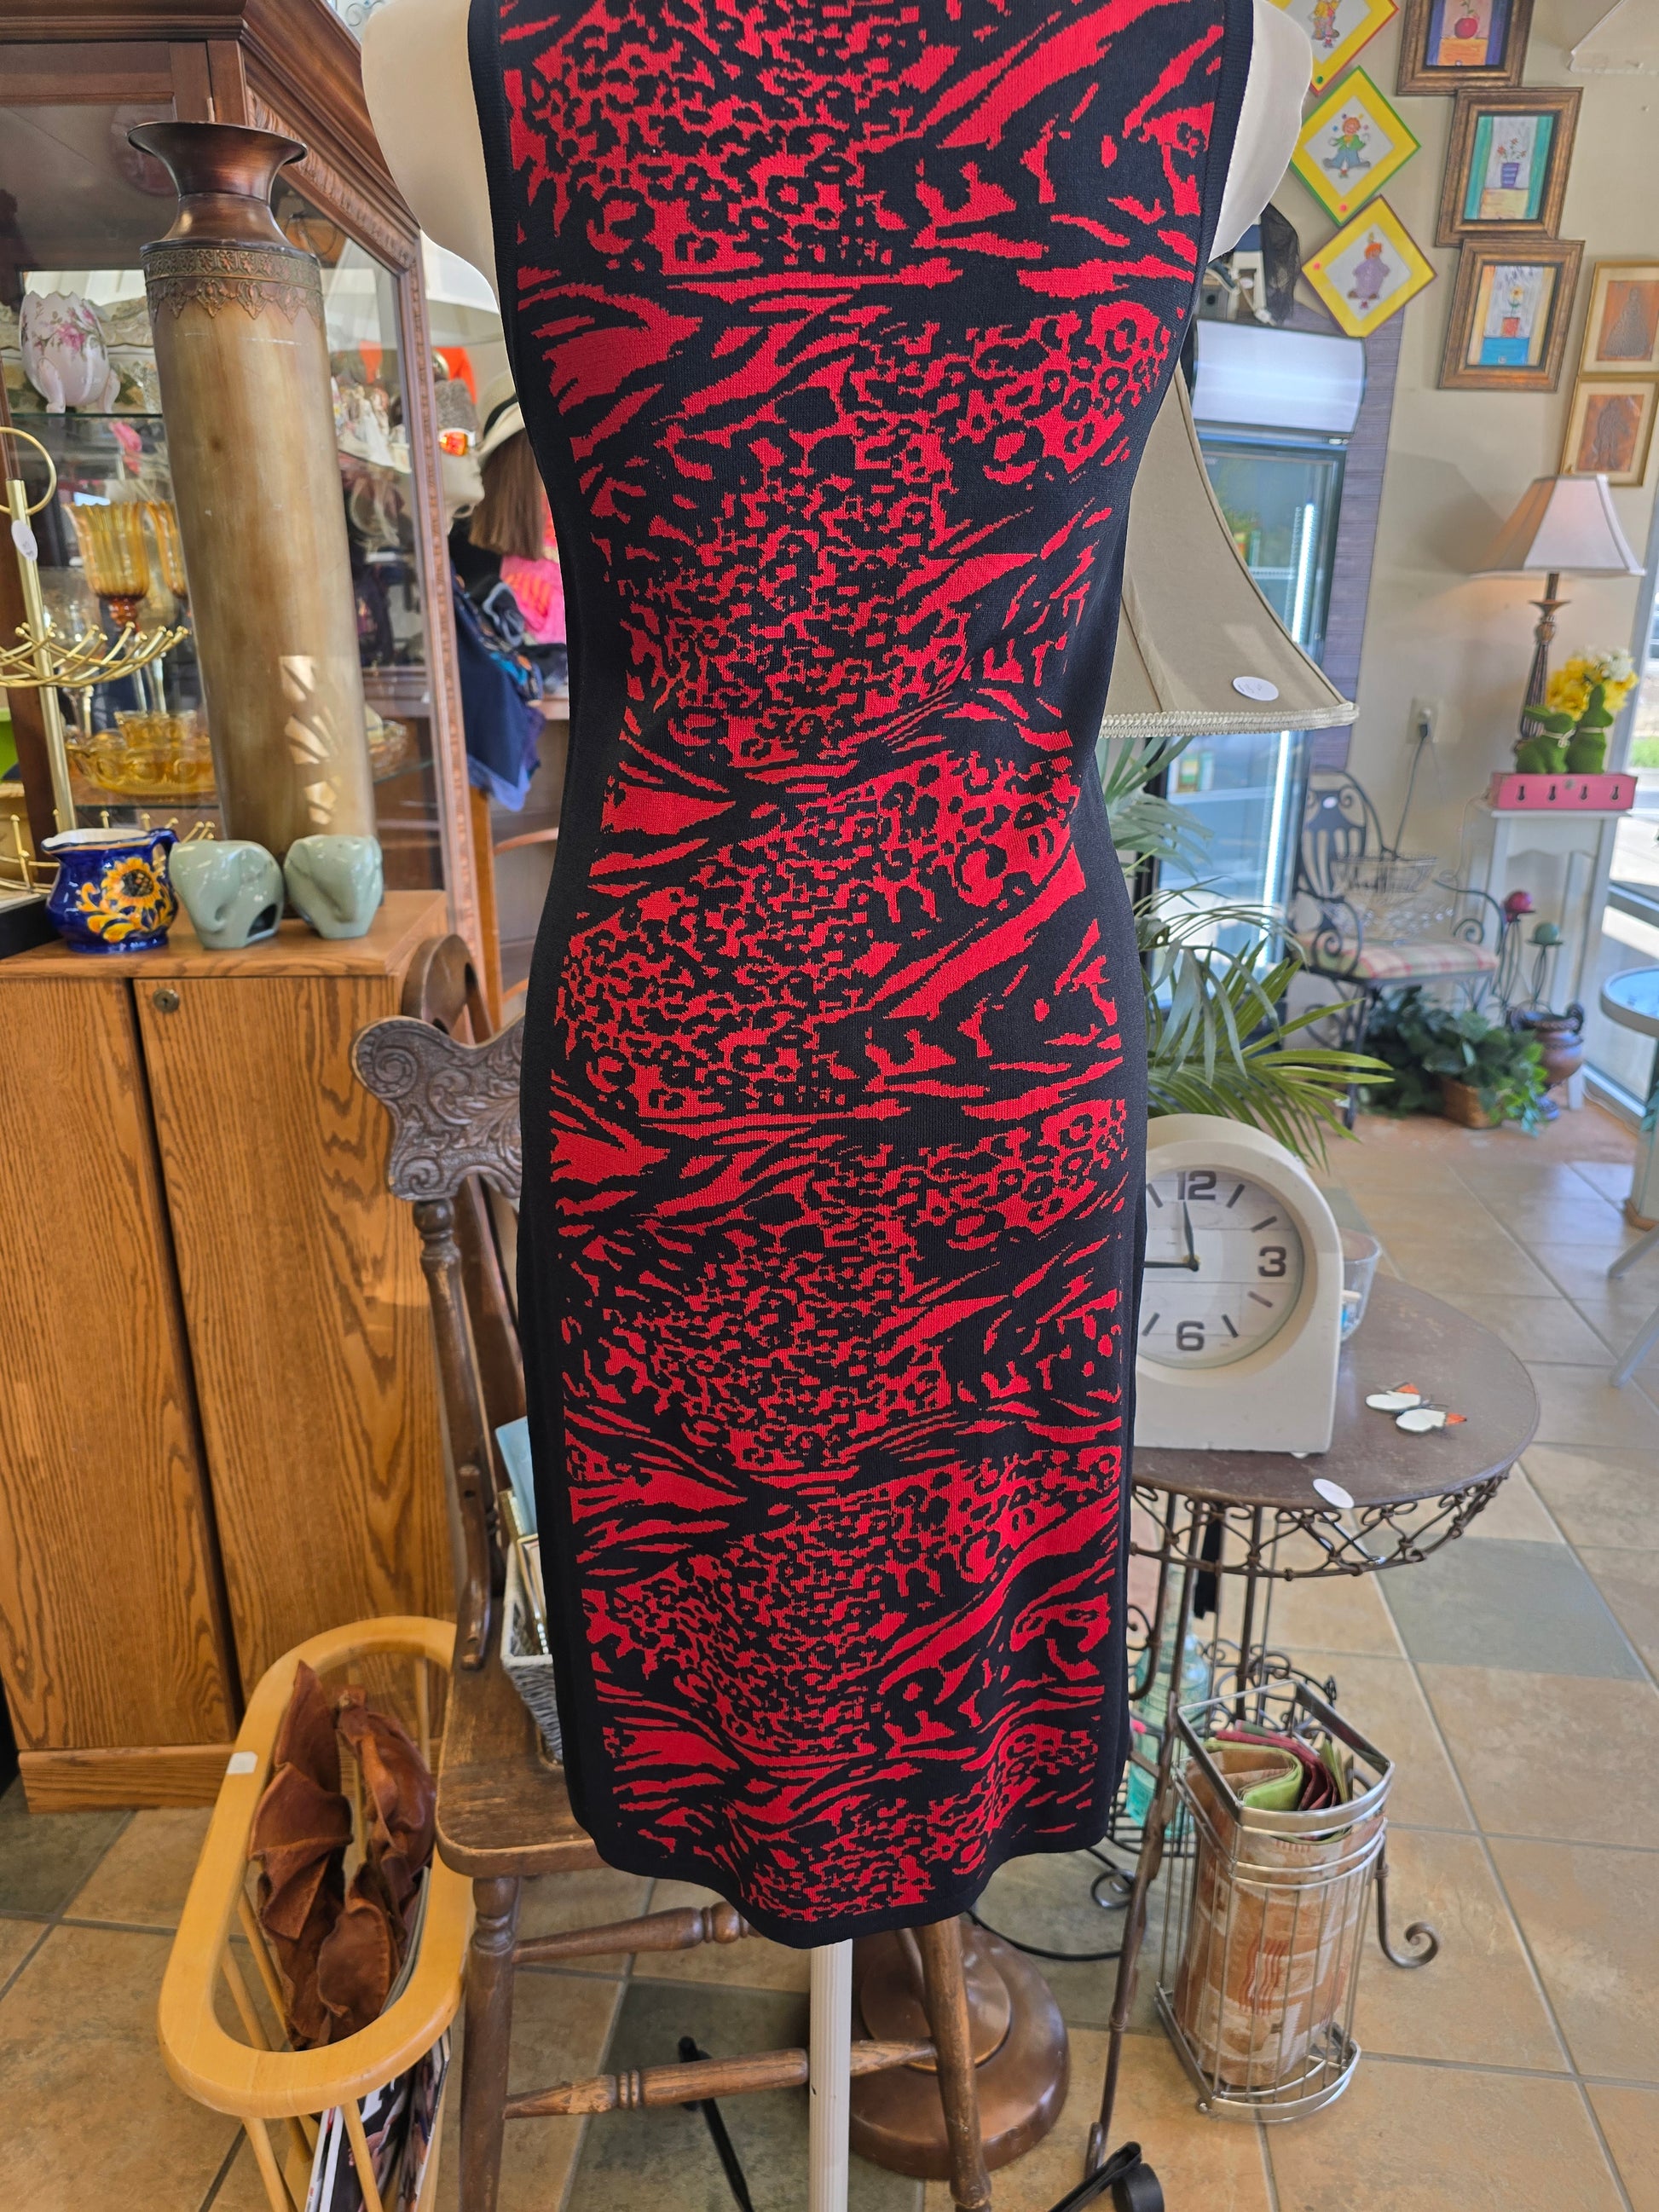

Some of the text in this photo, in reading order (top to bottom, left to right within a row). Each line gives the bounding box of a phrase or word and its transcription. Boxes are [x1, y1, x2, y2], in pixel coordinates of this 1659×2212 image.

[1176, 1170, 1217, 1200] 12
[1258, 1246, 1286, 1277] 3
[1176, 1320, 1205, 1351] 6
